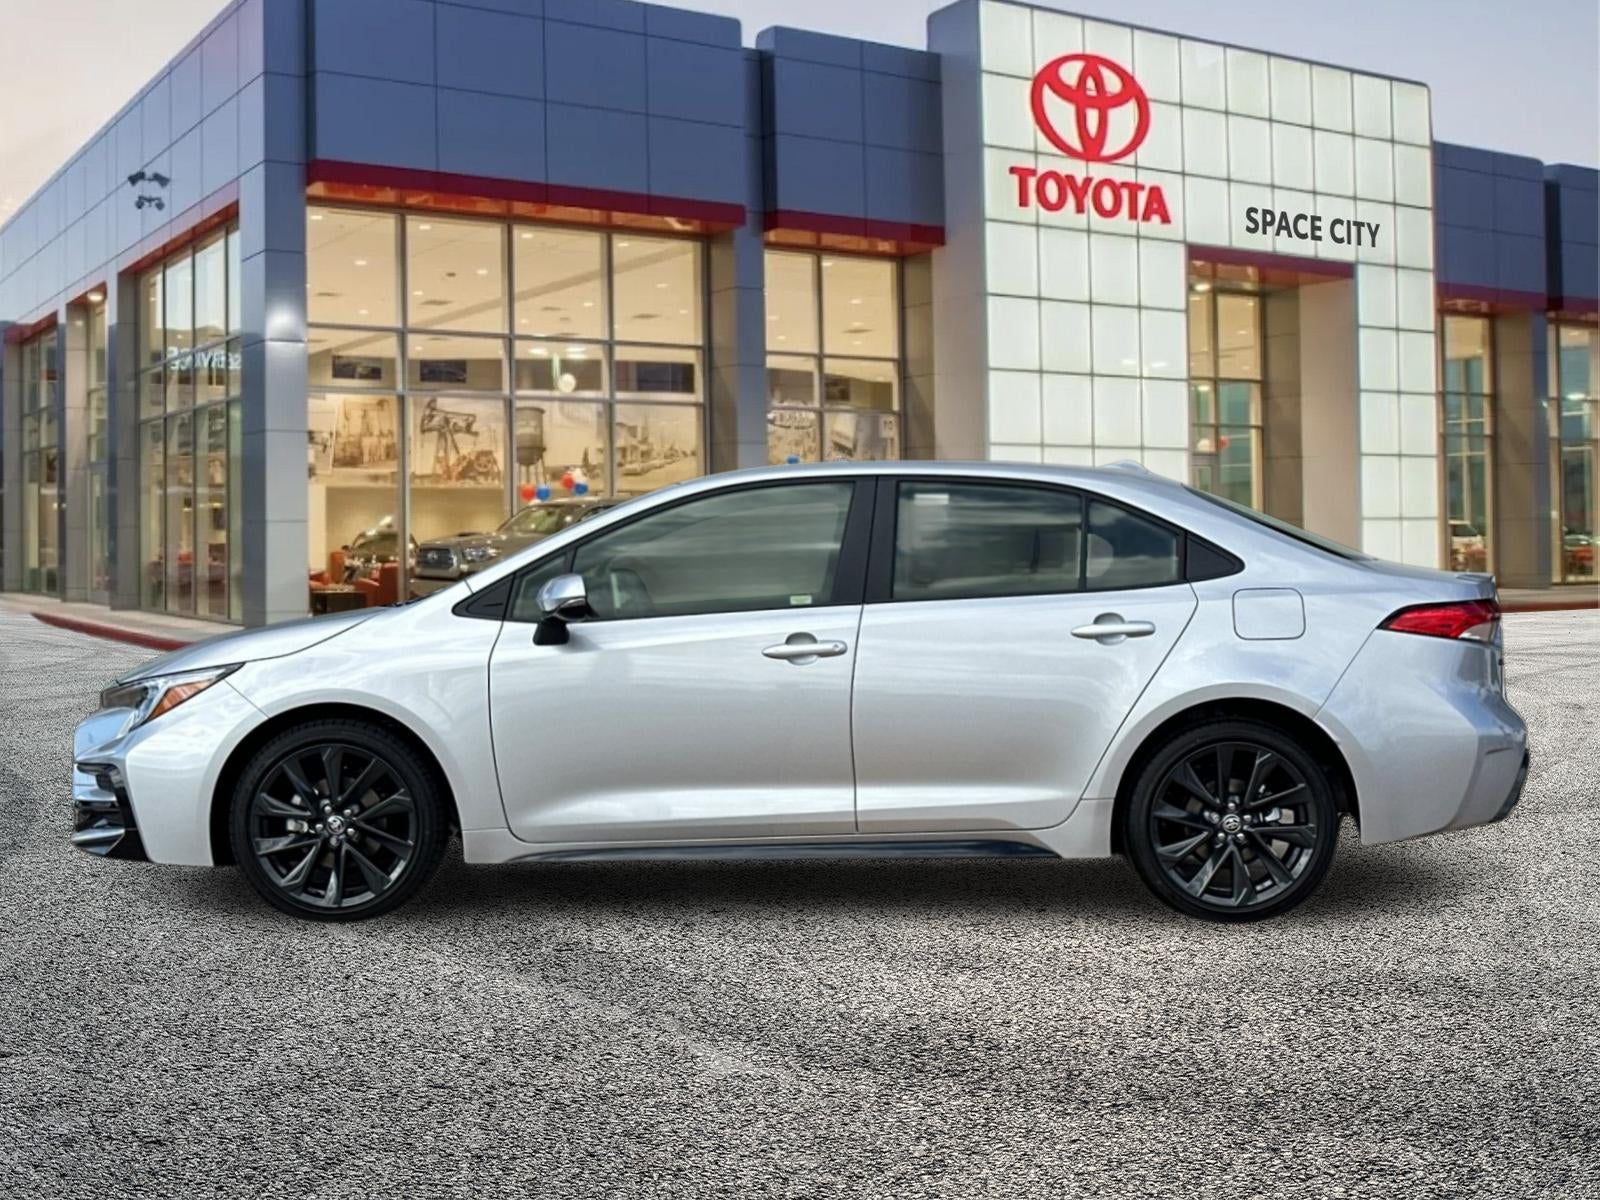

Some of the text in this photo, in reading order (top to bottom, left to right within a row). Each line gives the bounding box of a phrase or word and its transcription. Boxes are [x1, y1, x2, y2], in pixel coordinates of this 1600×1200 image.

[1010, 166, 1171, 224] TOYOTA
[1245, 206, 1380, 248] SPACE CITY
